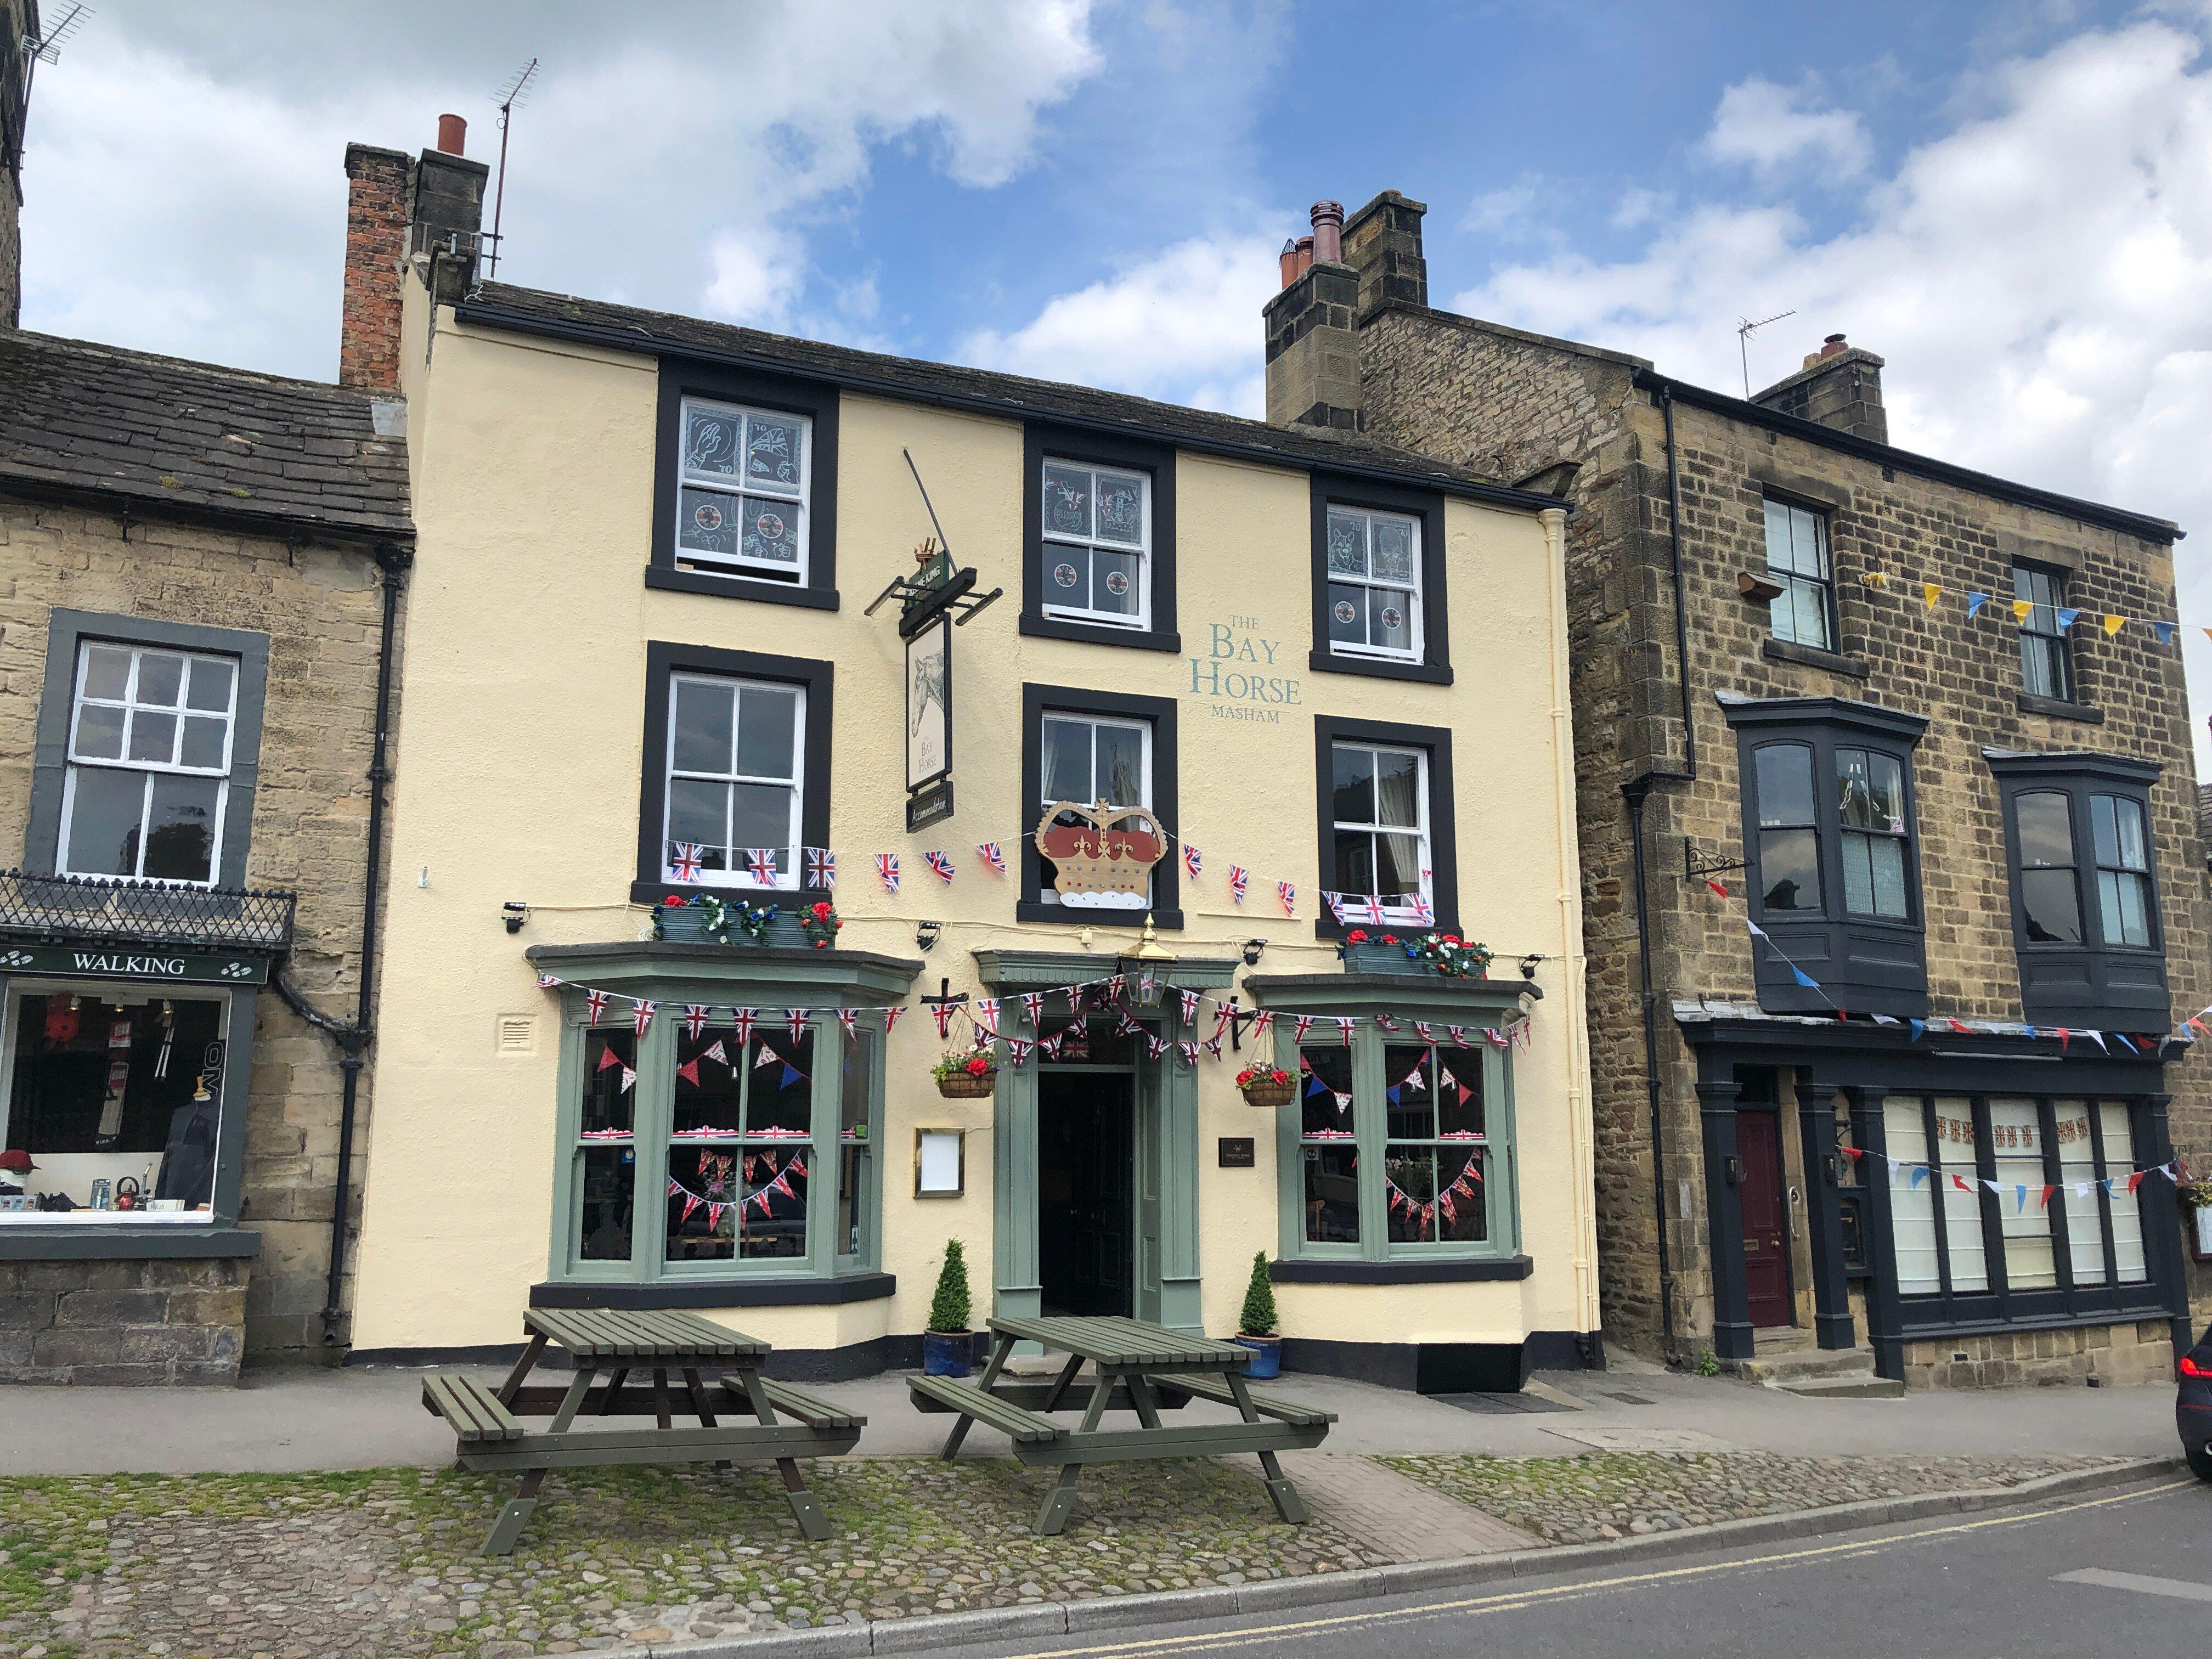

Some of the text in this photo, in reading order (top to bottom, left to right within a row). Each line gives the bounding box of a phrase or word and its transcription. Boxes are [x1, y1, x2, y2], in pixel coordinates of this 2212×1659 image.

[754, 423, 767, 432] 70
[719, 464, 733, 474] 70
[1350, 522, 1361, 531] 70
[1398, 529, 1407, 538] 70
[1228, 614, 1260, 630] THE
[1208, 623, 1281, 665] BAY
[1188, 658, 1302, 706] HORSE
[1211, 704, 1280, 724] MASHAM
[921, 741, 933, 757] BAY
[919, 755, 936, 773] HORSE
[73, 953, 186, 975] WALKING
